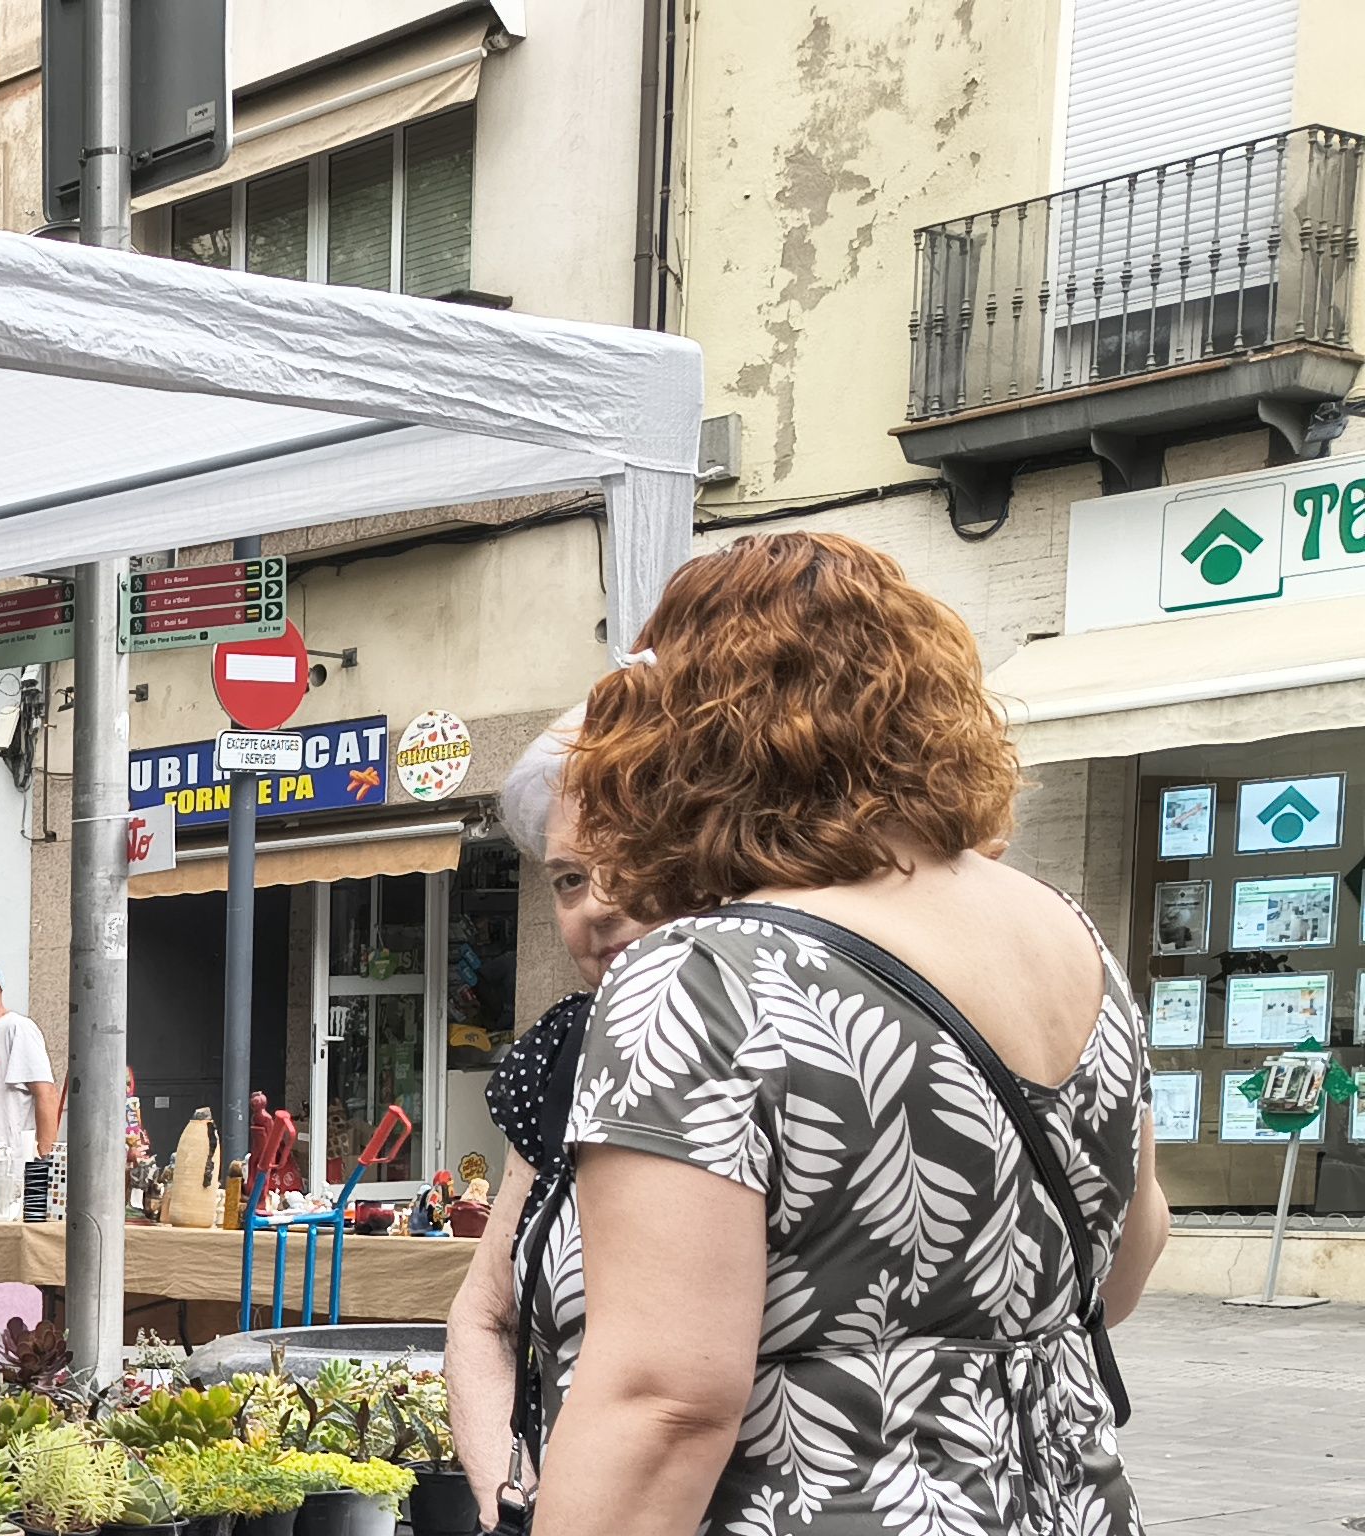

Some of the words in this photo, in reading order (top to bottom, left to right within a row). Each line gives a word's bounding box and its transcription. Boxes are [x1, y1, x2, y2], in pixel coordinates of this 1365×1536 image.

[226, 737, 259, 750] EXCEPTE
[259, 739, 300, 751] GARATGES
[396, 740, 472, 767] CHUCHES
[245, 753, 277, 765] SERVEIS
[278, 774, 315, 801] PA
